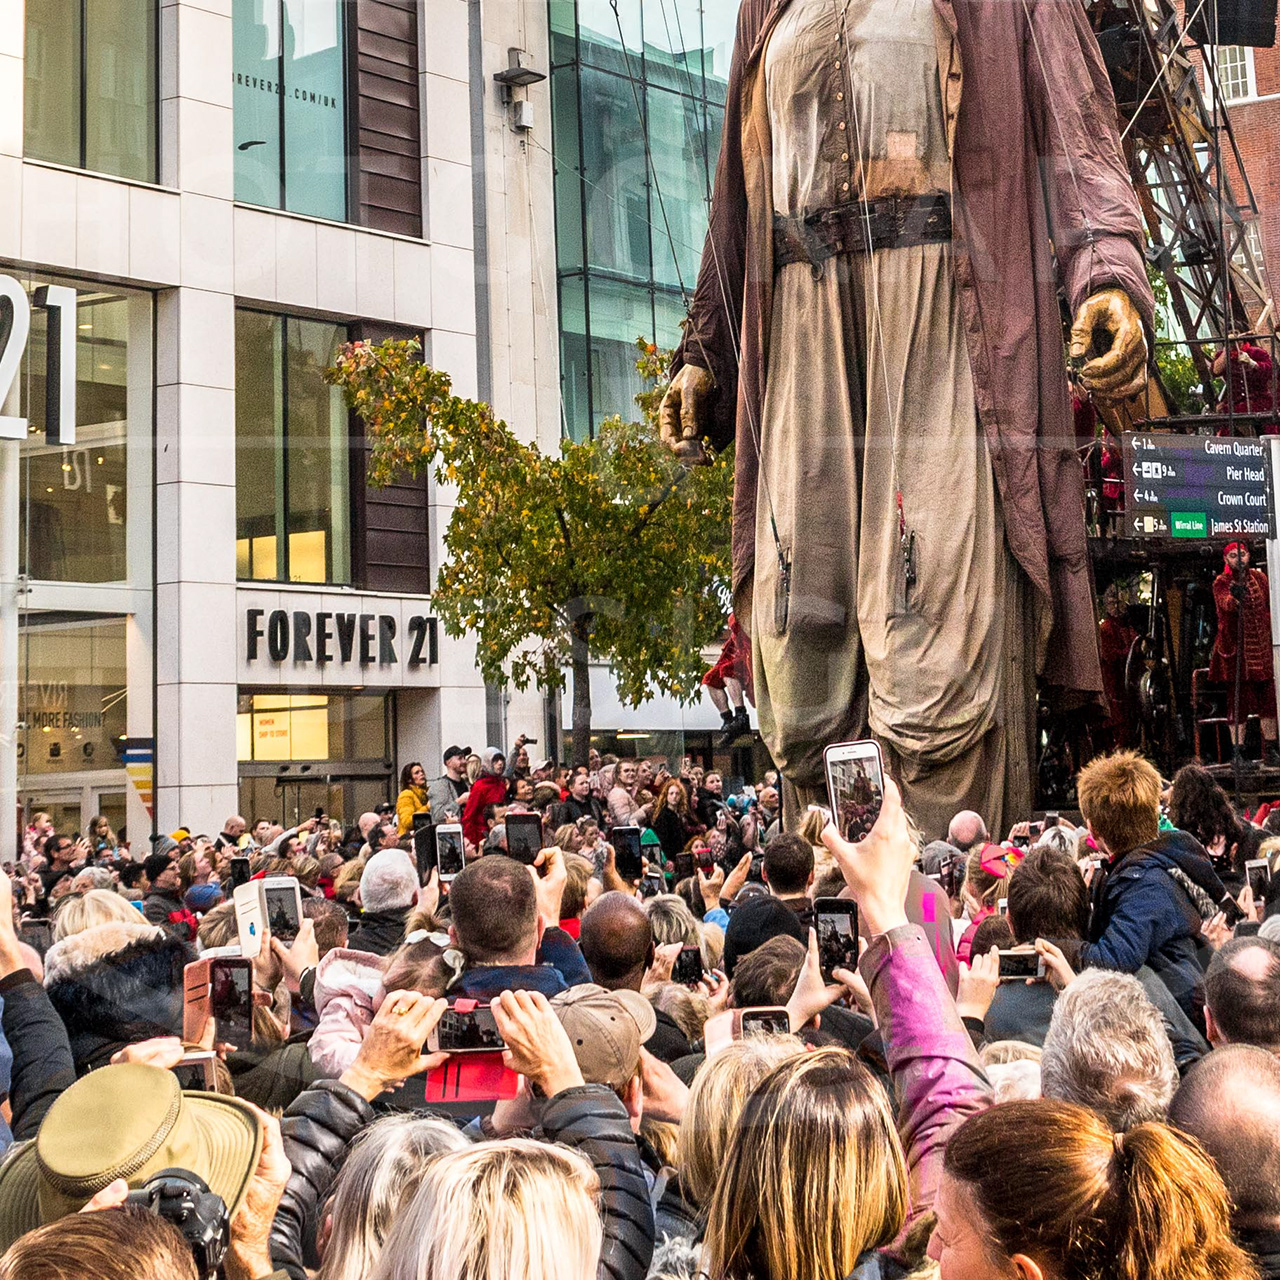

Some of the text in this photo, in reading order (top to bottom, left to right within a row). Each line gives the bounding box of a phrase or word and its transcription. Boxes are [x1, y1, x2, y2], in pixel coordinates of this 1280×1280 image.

[1205, 440, 1232, 455] Cavern
[1233, 442, 1263, 457] Quarter
[1227, 466, 1243, 480] Pier
[1245, 468, 1265, 481] Head
[1218, 491, 1243, 505] Crown
[1245, 492, 1267, 506] Court
[1193, 521, 1203, 530] Line
[1211, 519, 1233, 536] James
[1234, 519, 1243, 533] St
[1243, 519, 1269, 533] Station
[246, 608, 439, 664] FOREVER 21
[33, 711, 60, 729] MORE
